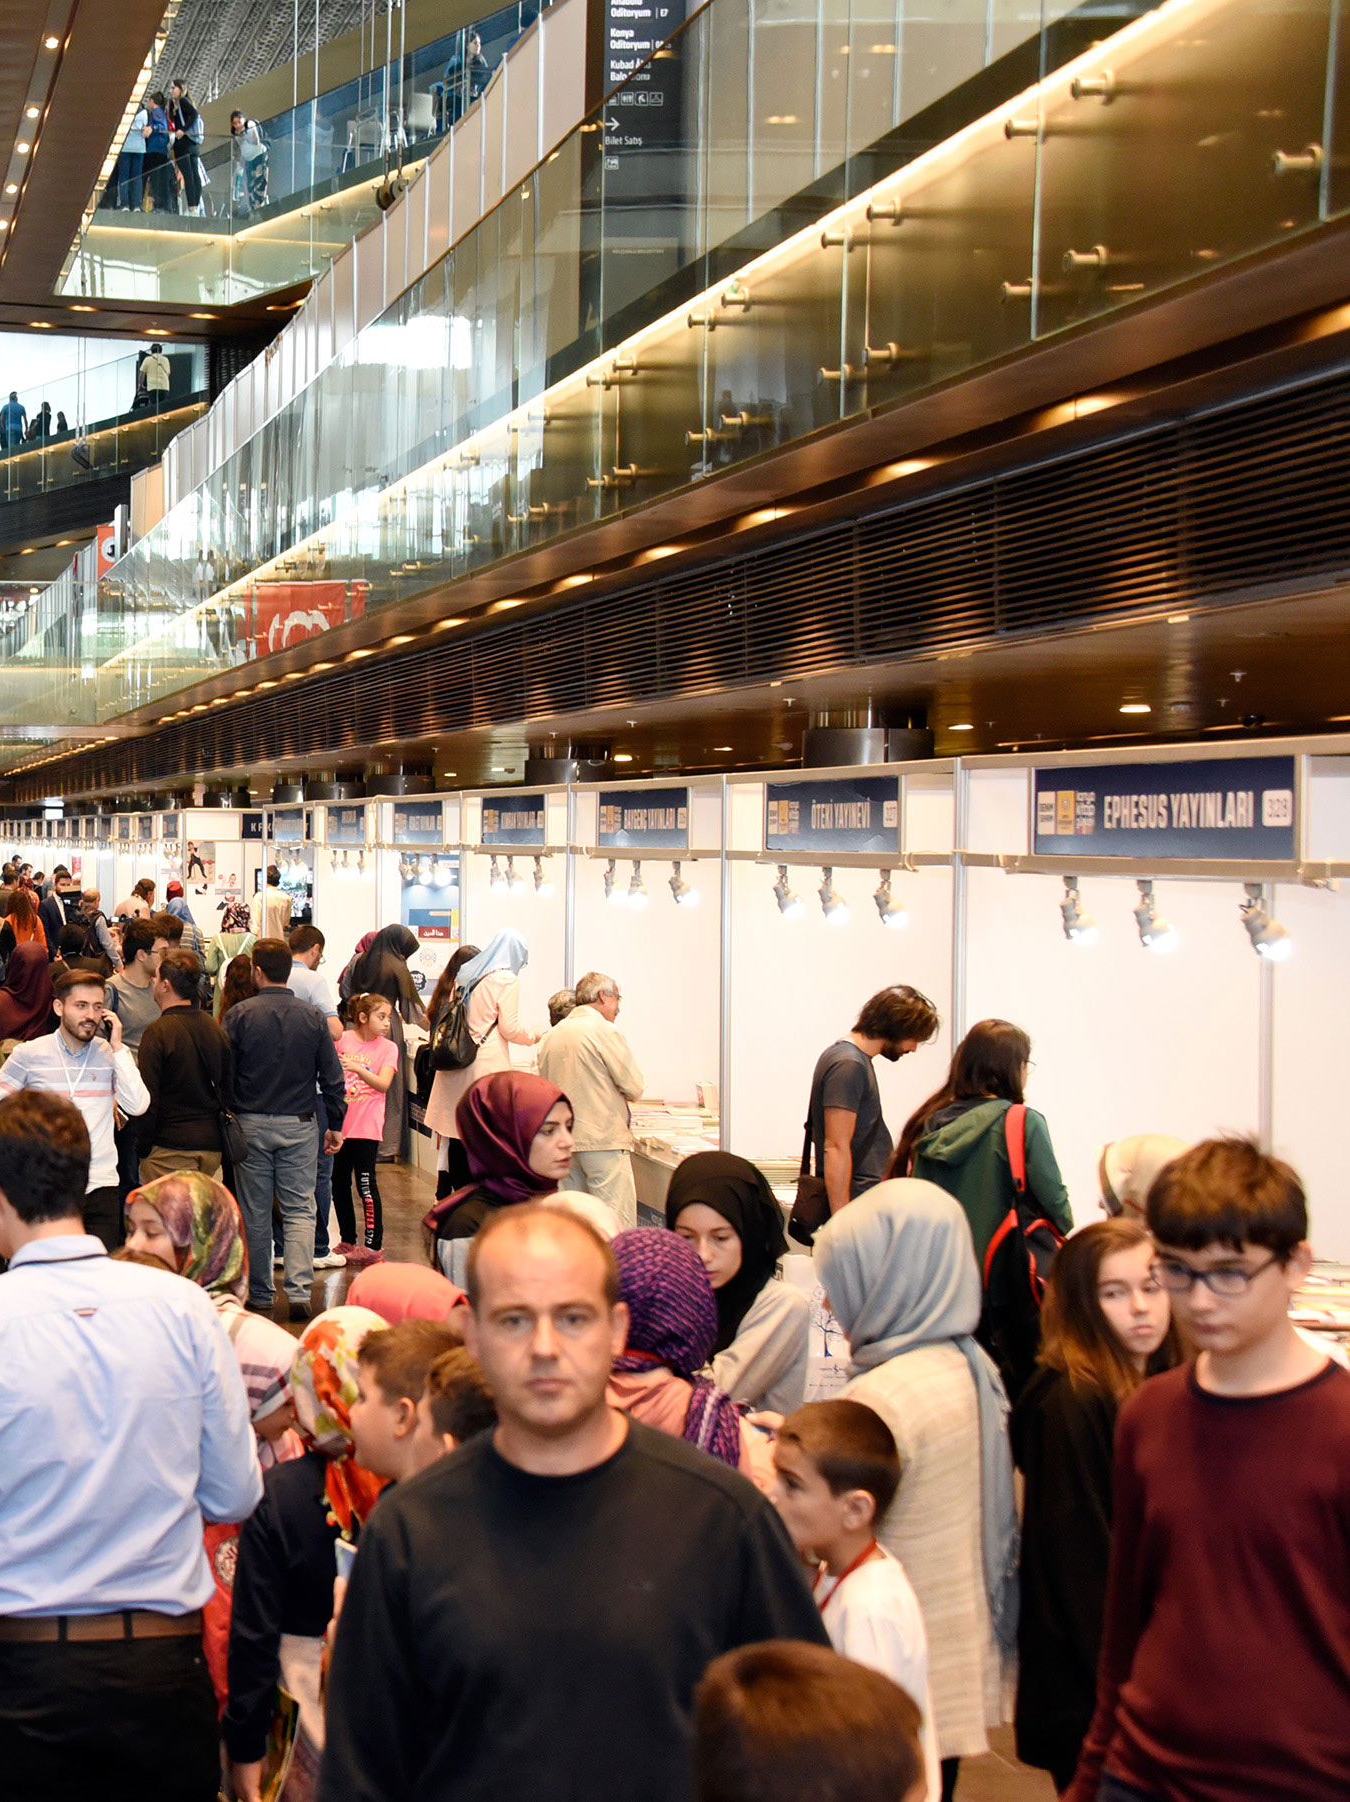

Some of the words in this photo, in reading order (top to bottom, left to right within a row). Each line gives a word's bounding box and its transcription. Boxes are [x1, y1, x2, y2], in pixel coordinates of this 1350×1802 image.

[610, 7, 651, 19] Oditoryum
[610, 27, 634, 39] Konya
[610, 39, 650, 51] Oditoryum
[610, 59, 634, 69] Kubad
[604, 135, 623, 145] Bilet
[1103, 794, 1168, 829] EPHESUS
[1169, 791, 1254, 829] YAYINLARI
